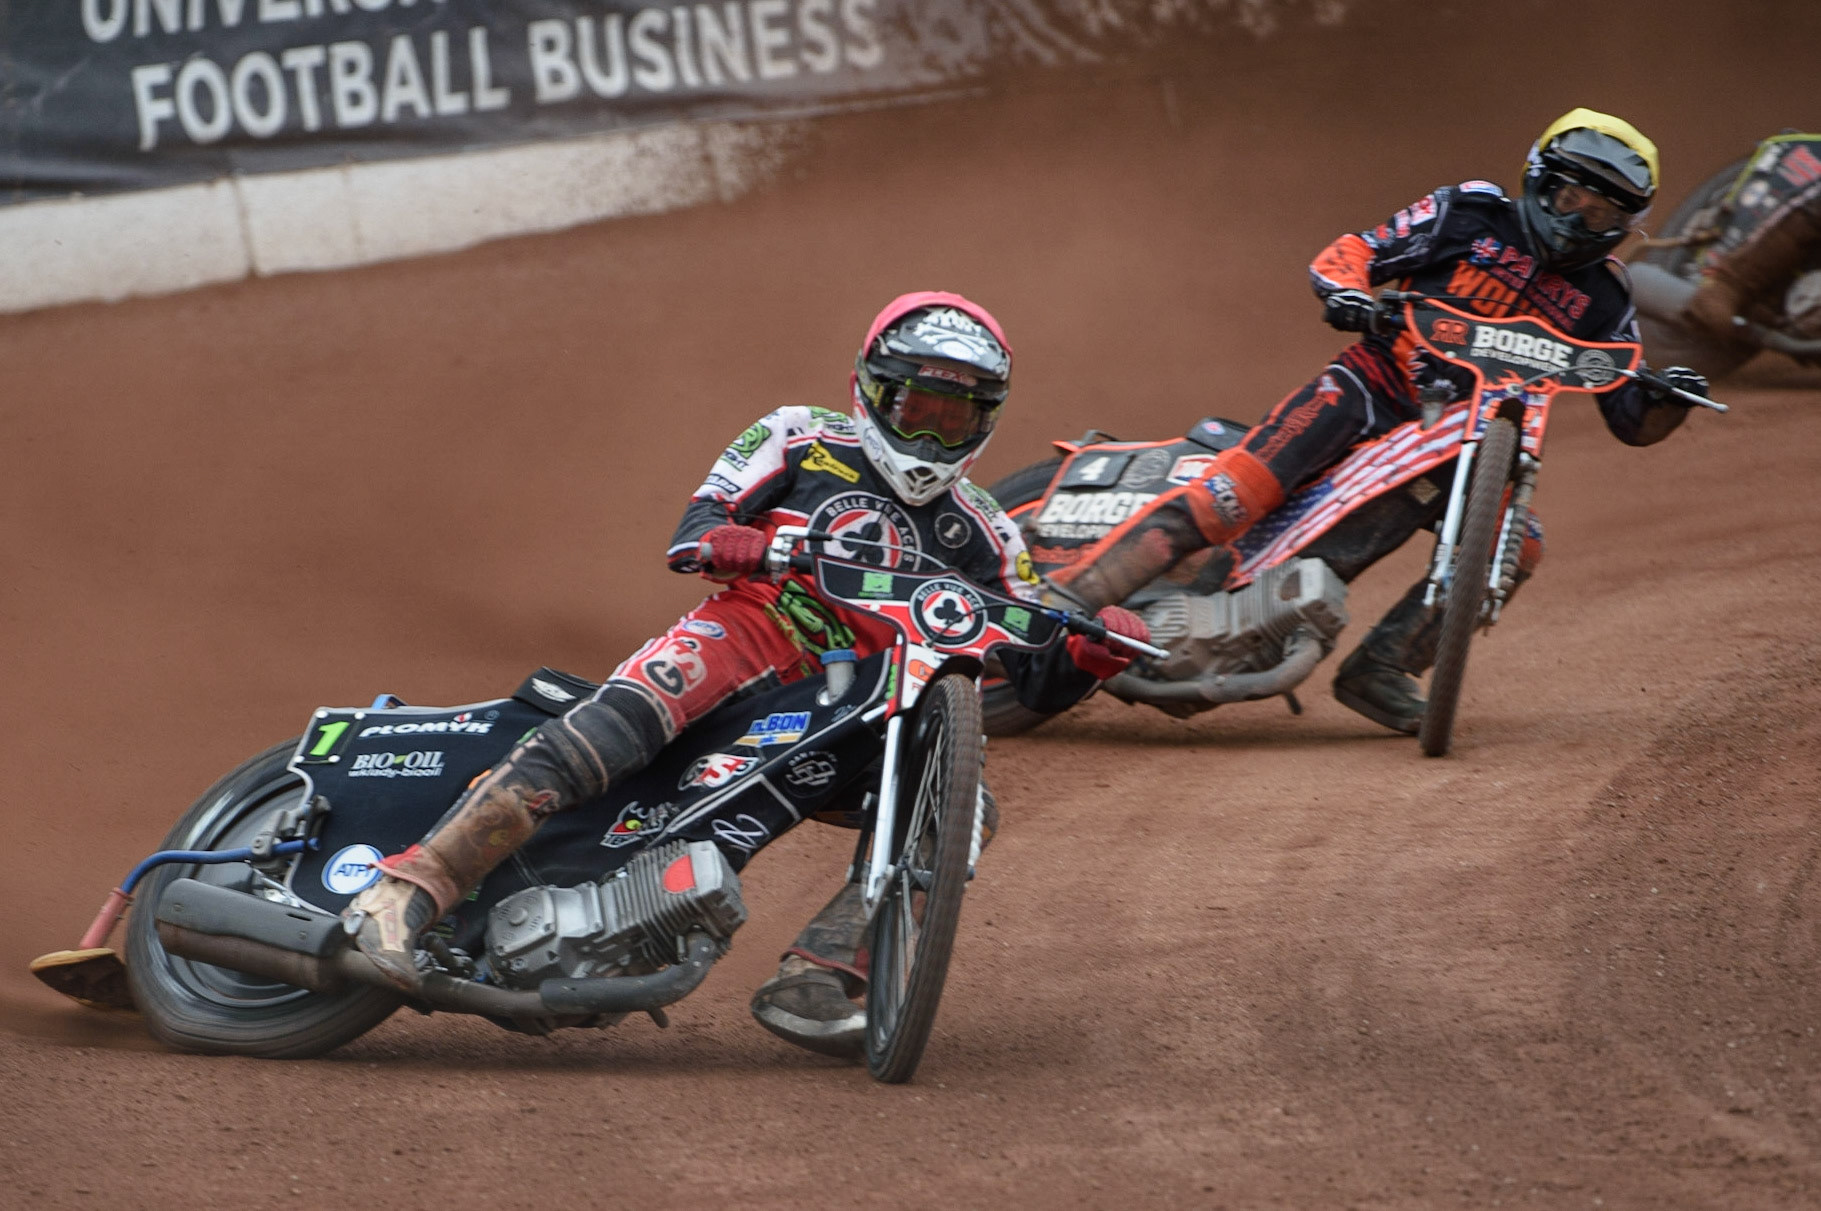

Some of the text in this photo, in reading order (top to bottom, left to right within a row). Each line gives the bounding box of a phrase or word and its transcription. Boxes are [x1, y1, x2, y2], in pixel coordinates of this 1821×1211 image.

[131, 0, 885, 150] FOOTBALL BUSINESS
[1472, 325, 1574, 368] BORGE
[825, 498, 868, 518] BELLE
[309, 721, 350, 756] 1
